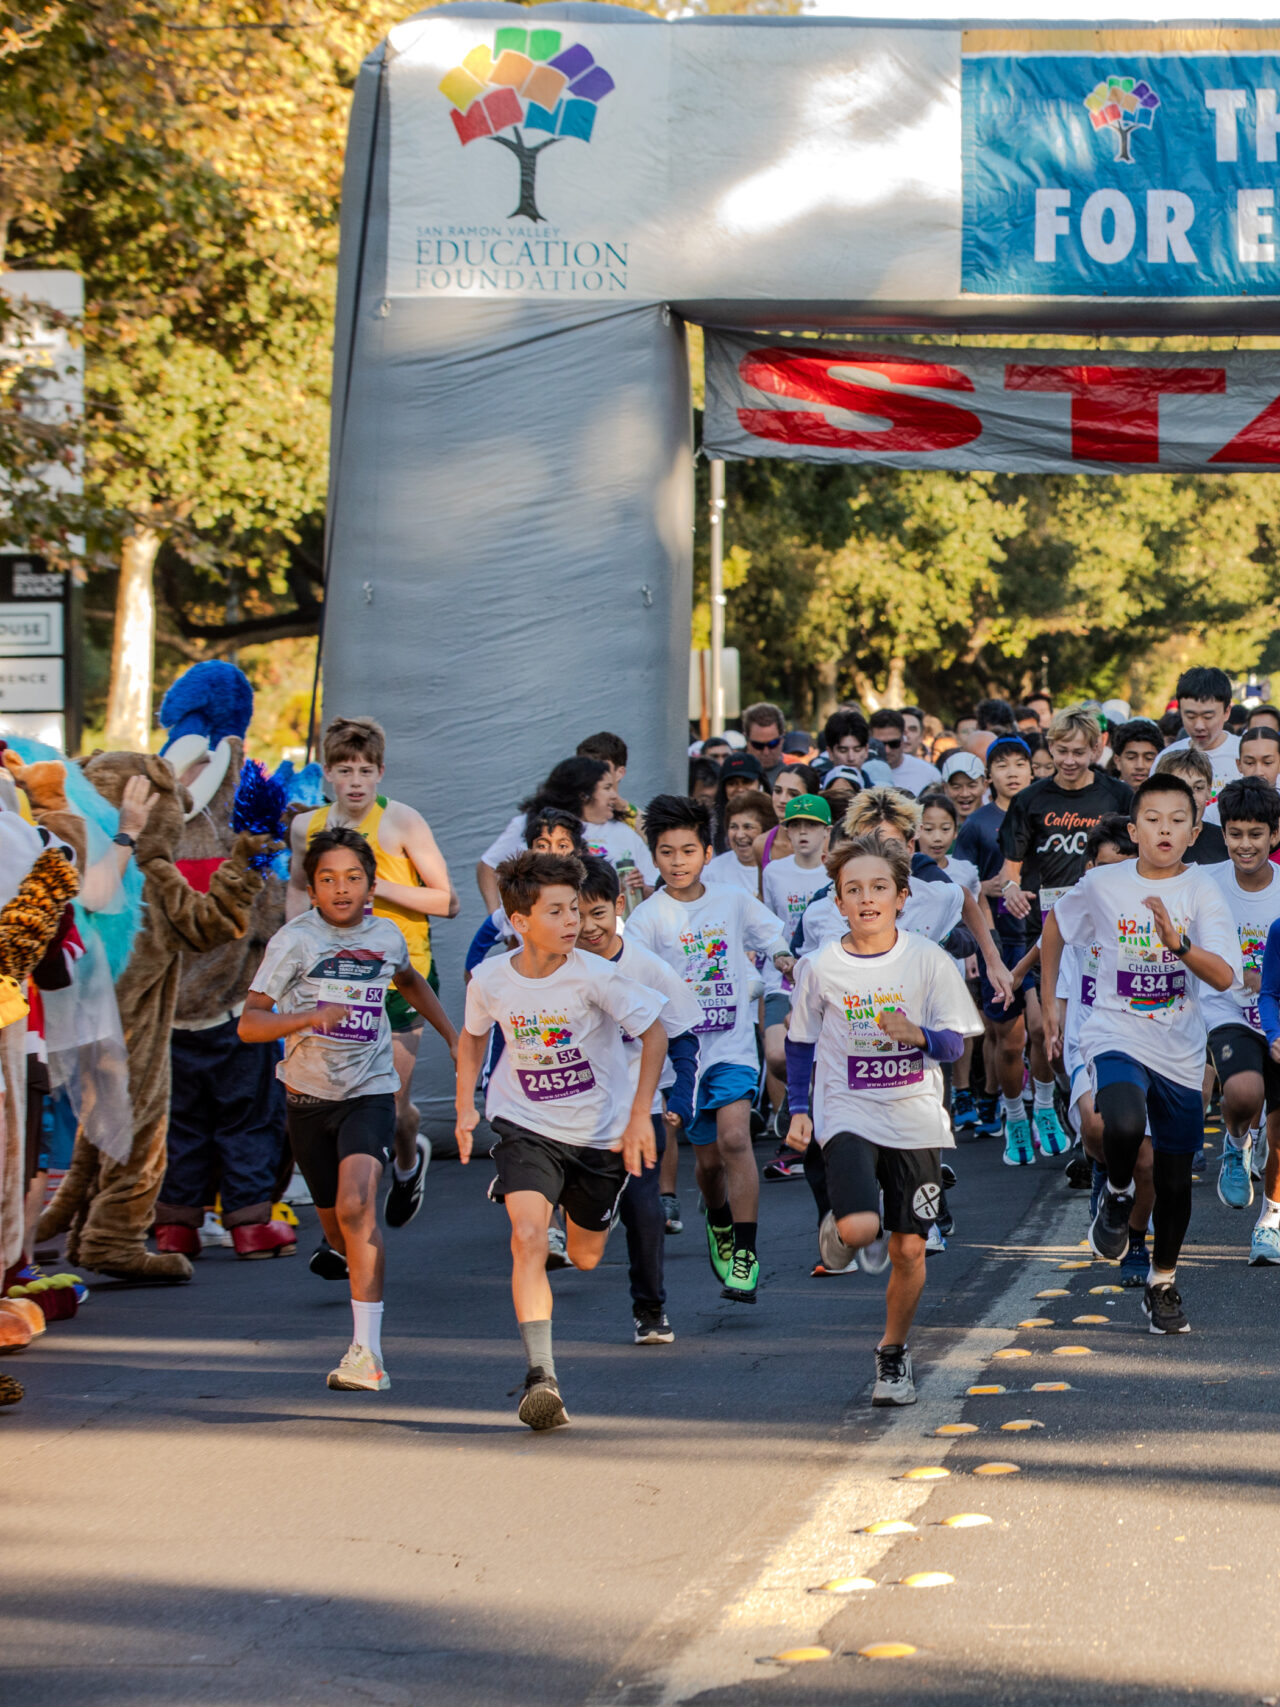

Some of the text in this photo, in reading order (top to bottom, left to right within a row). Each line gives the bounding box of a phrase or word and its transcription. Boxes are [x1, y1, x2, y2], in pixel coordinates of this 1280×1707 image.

[416, 226, 560, 238] SAN RAMON VALLEY
[1034, 188, 1198, 264] FOR
[416, 239, 629, 268] EDUCATION
[416, 268, 628, 291] FOUNDATION
[1044, 811, 1102, 830] Californi
[1118, 918, 1151, 936] 42nd
[1241, 926, 1268, 939] ANNUAL
[679, 930, 702, 945] 42nd
[683, 940, 706, 956] RUN
[1128, 963, 1176, 973] CHARLES
[717, 984, 731, 994] 5K
[1130, 975, 1168, 992] 434
[367, 989, 382, 1001] 5K
[843, 992, 906, 1008] 42nd ANNUAL
[701, 1008, 728, 1027] 98
[845, 1006, 875, 1021] RUN
[510, 1014, 571, 1029] 42nd ANNUAL
[852, 1021, 872, 1031] FOR
[513, 1026, 541, 1039] RUN
[520, 1038, 539, 1046] FOR
[560, 1049, 579, 1063] 5K
[855, 1059, 911, 1078] 2308
[525, 1069, 580, 1092] 2452
[867, 1080, 908, 1088] www.srvef.org
